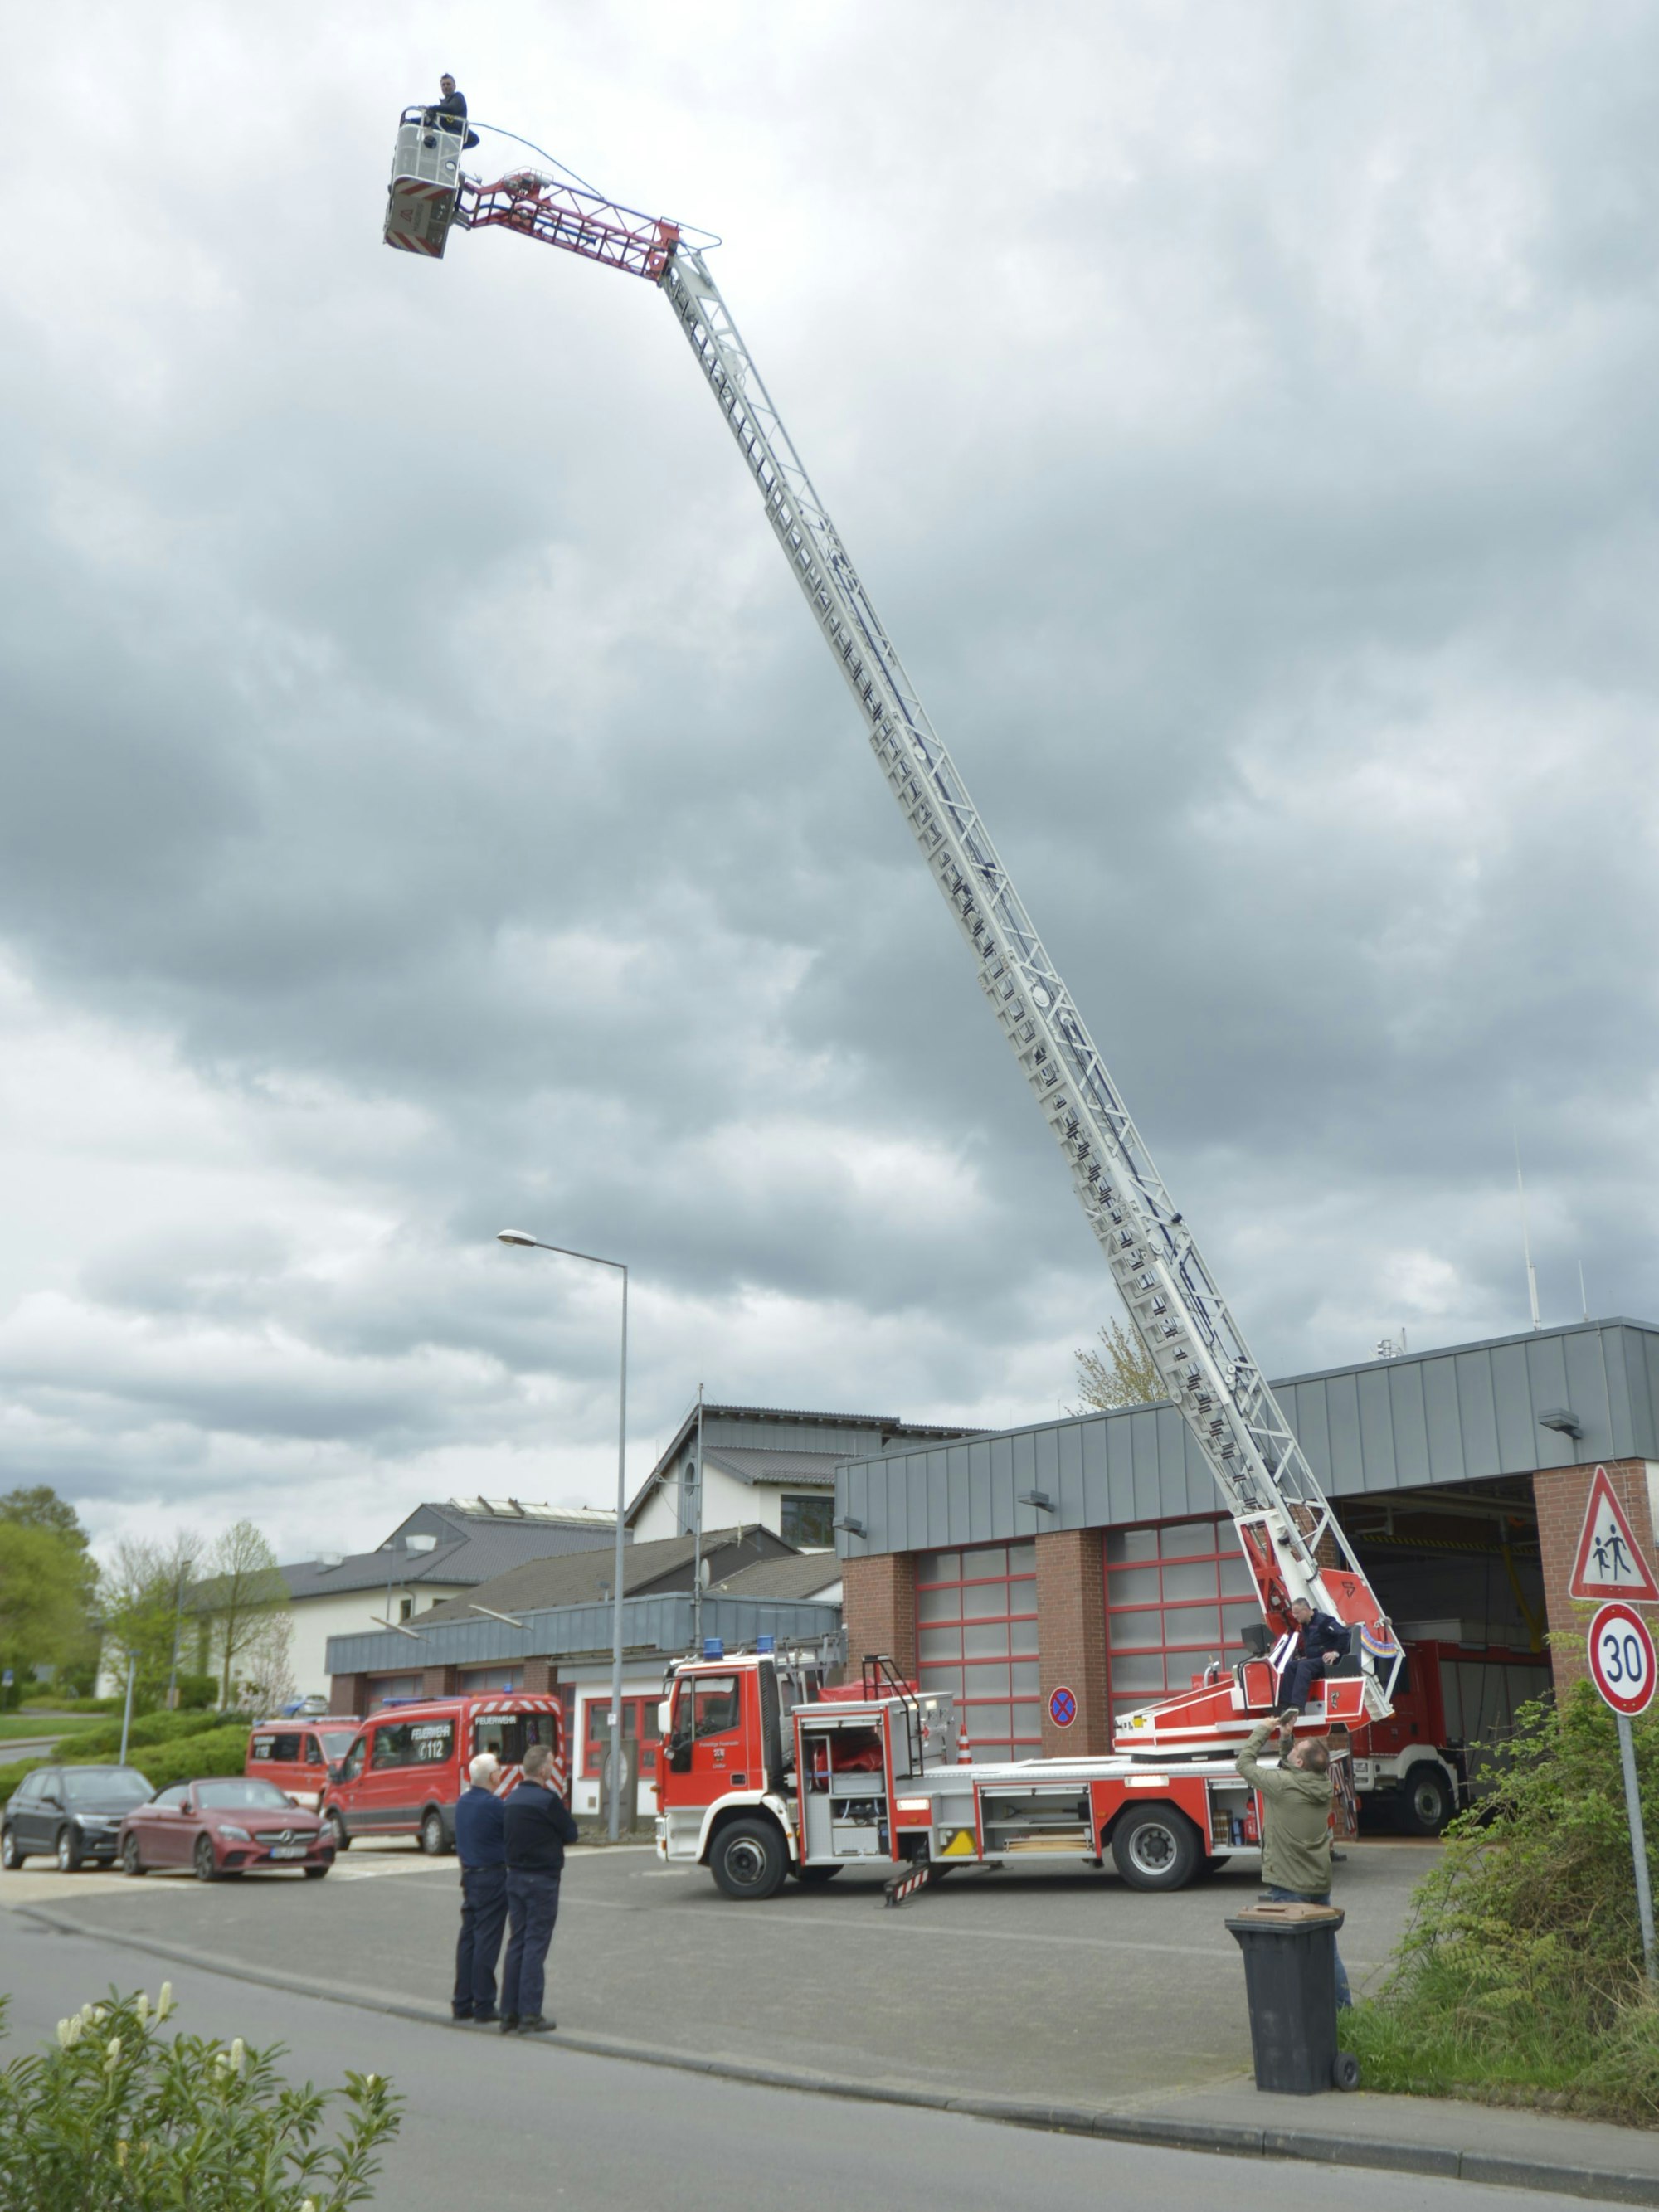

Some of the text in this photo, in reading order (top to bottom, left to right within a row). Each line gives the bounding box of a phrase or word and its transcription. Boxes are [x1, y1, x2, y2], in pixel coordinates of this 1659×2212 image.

[1603, 1634, 1642, 1682] 30
[475, 1716, 516, 1725] FEUERWEHR
[411, 1726, 450, 1740] FEUERWEHR
[426, 1740, 443, 1757] 112
